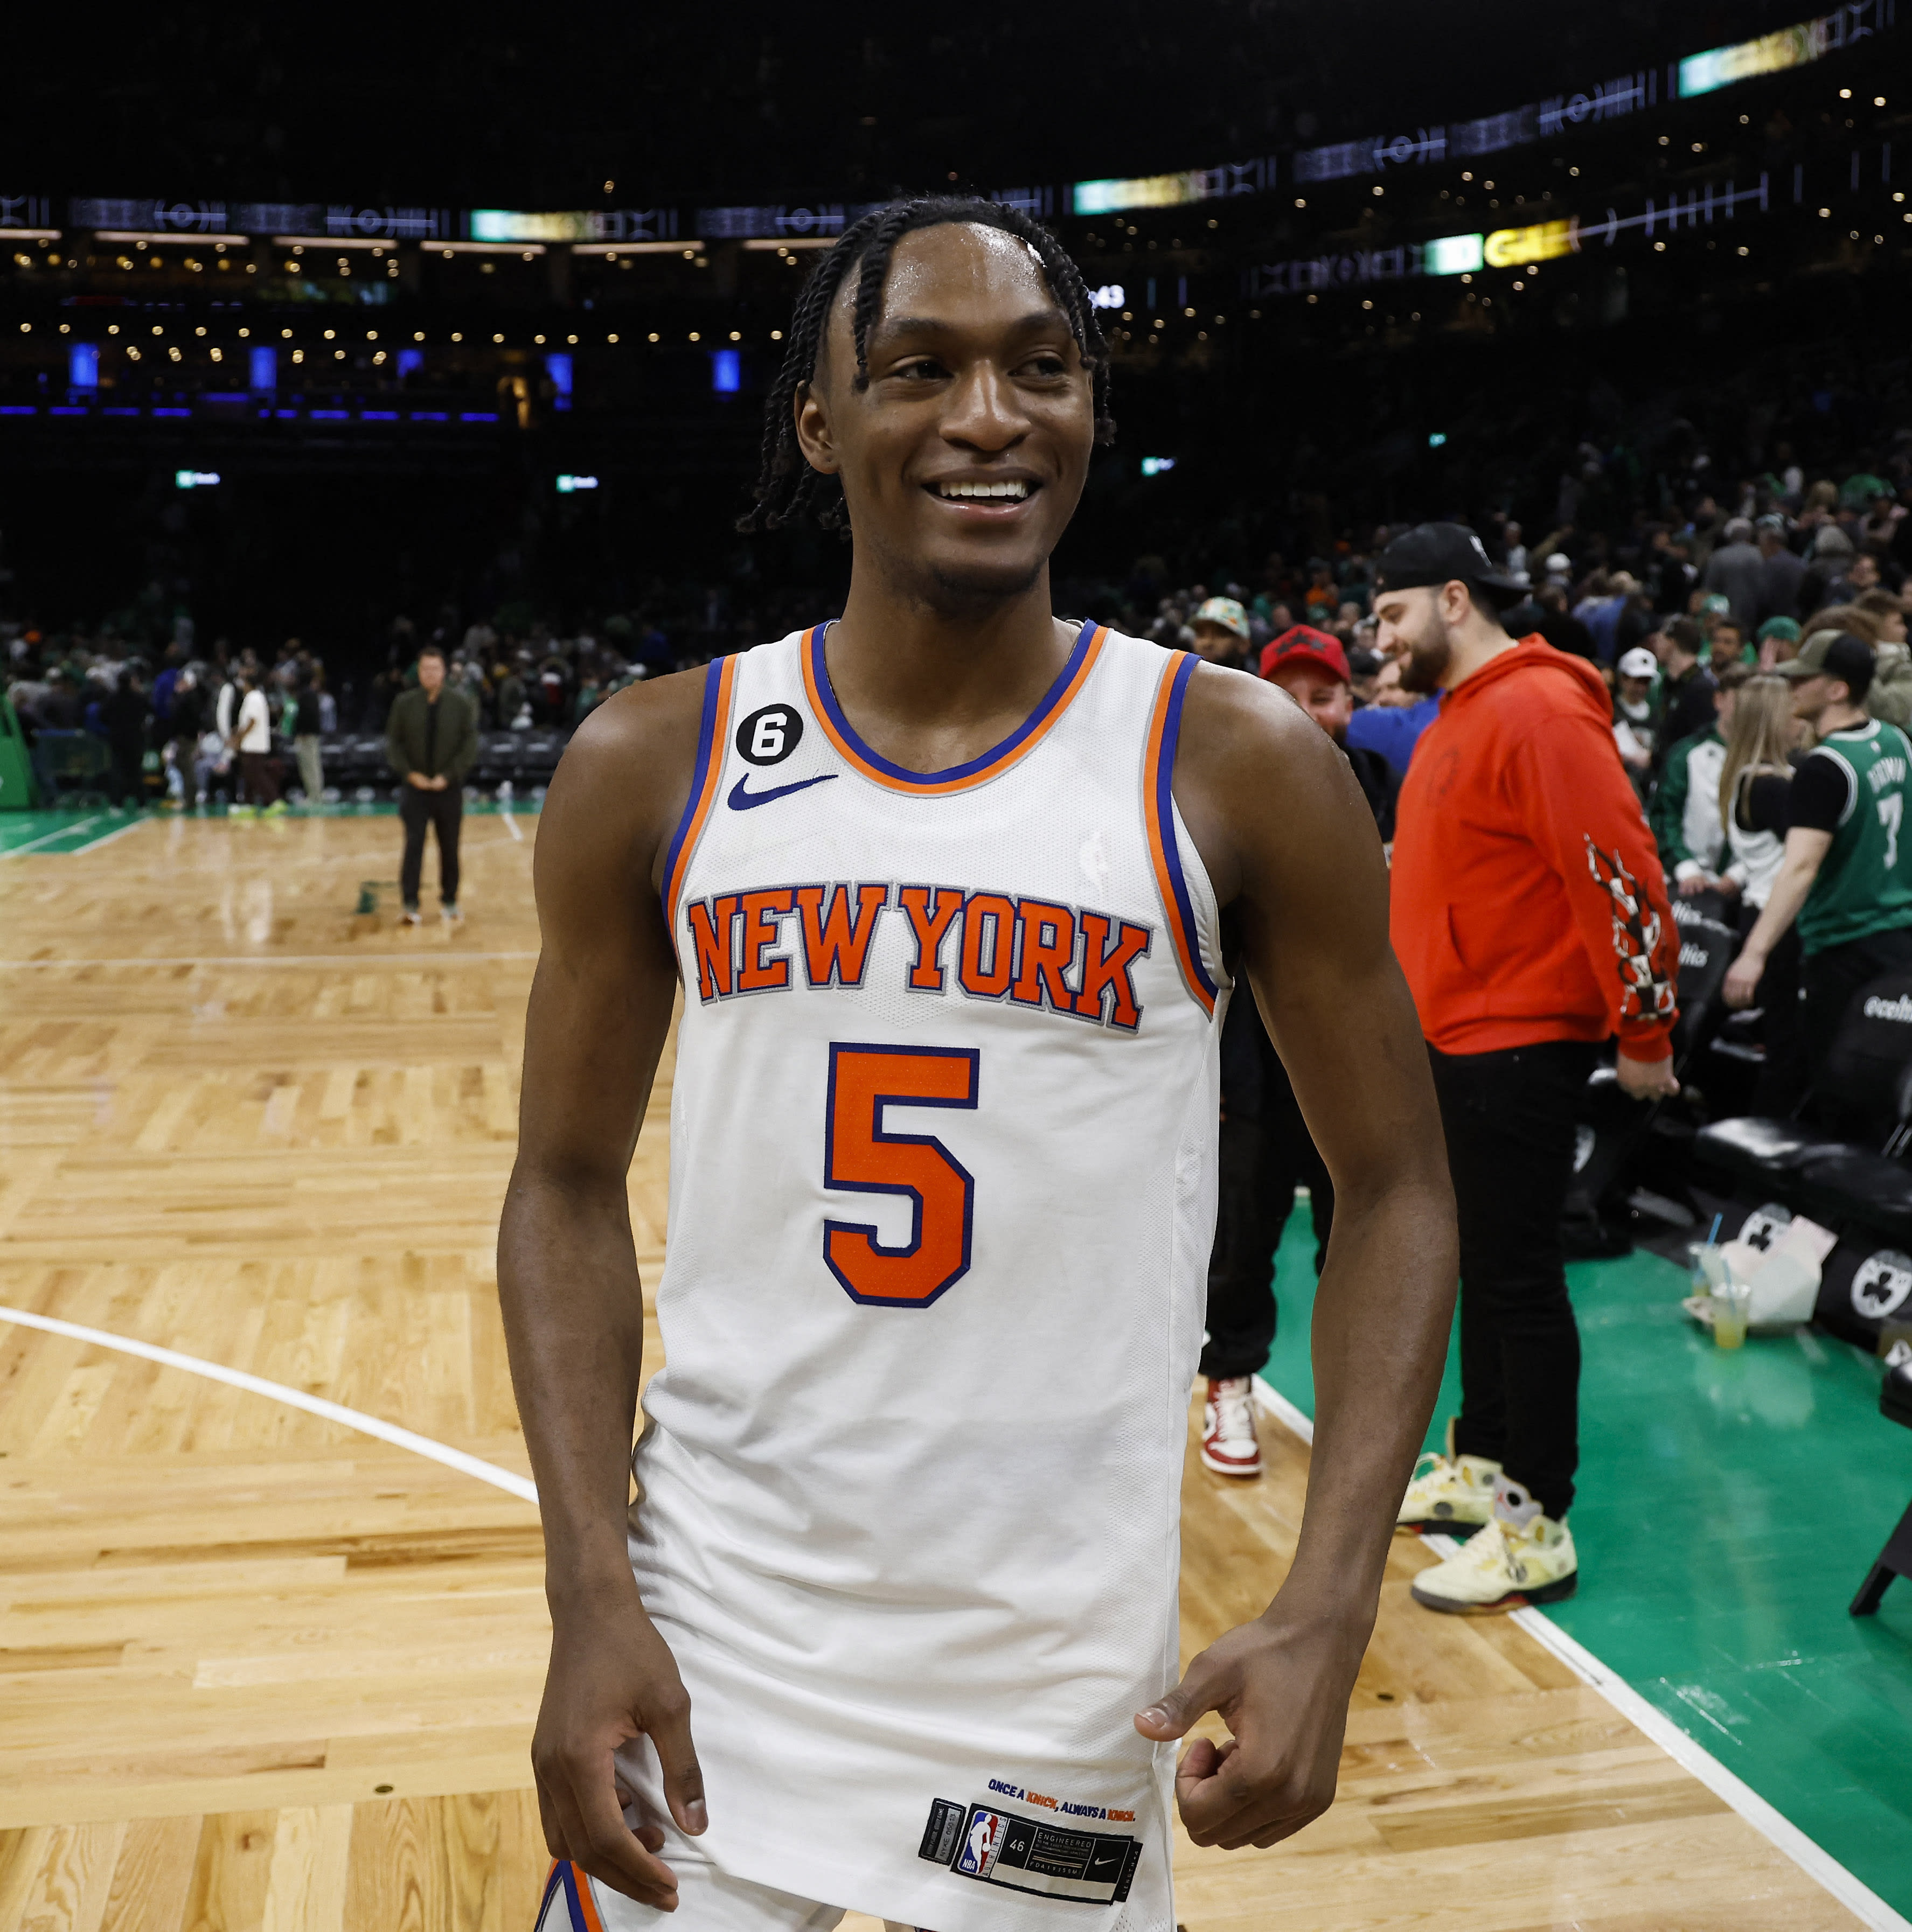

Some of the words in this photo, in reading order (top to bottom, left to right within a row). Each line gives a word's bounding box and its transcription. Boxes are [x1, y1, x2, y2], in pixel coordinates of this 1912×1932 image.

[750, 712, 788, 757] 6
[1877, 791, 1903, 870] 7
[686, 881, 893, 1006] NEW
[895, 881, 1154, 1034] YORK
[823, 1042, 980, 1308] 5
[988, 1778, 1017, 1797] ONCE
[1016, 1789, 1024, 1801] A
[1060, 1802, 1100, 1818] ALWAYS
[1098, 1808, 1106, 1820] A
[982, 1817, 1007, 1877] AUTHENTICS
[1009, 1840, 1025, 1852] 46
[1038, 1832, 1091, 1849] ENGINEERED
[962, 1858, 976, 1871] NBA
